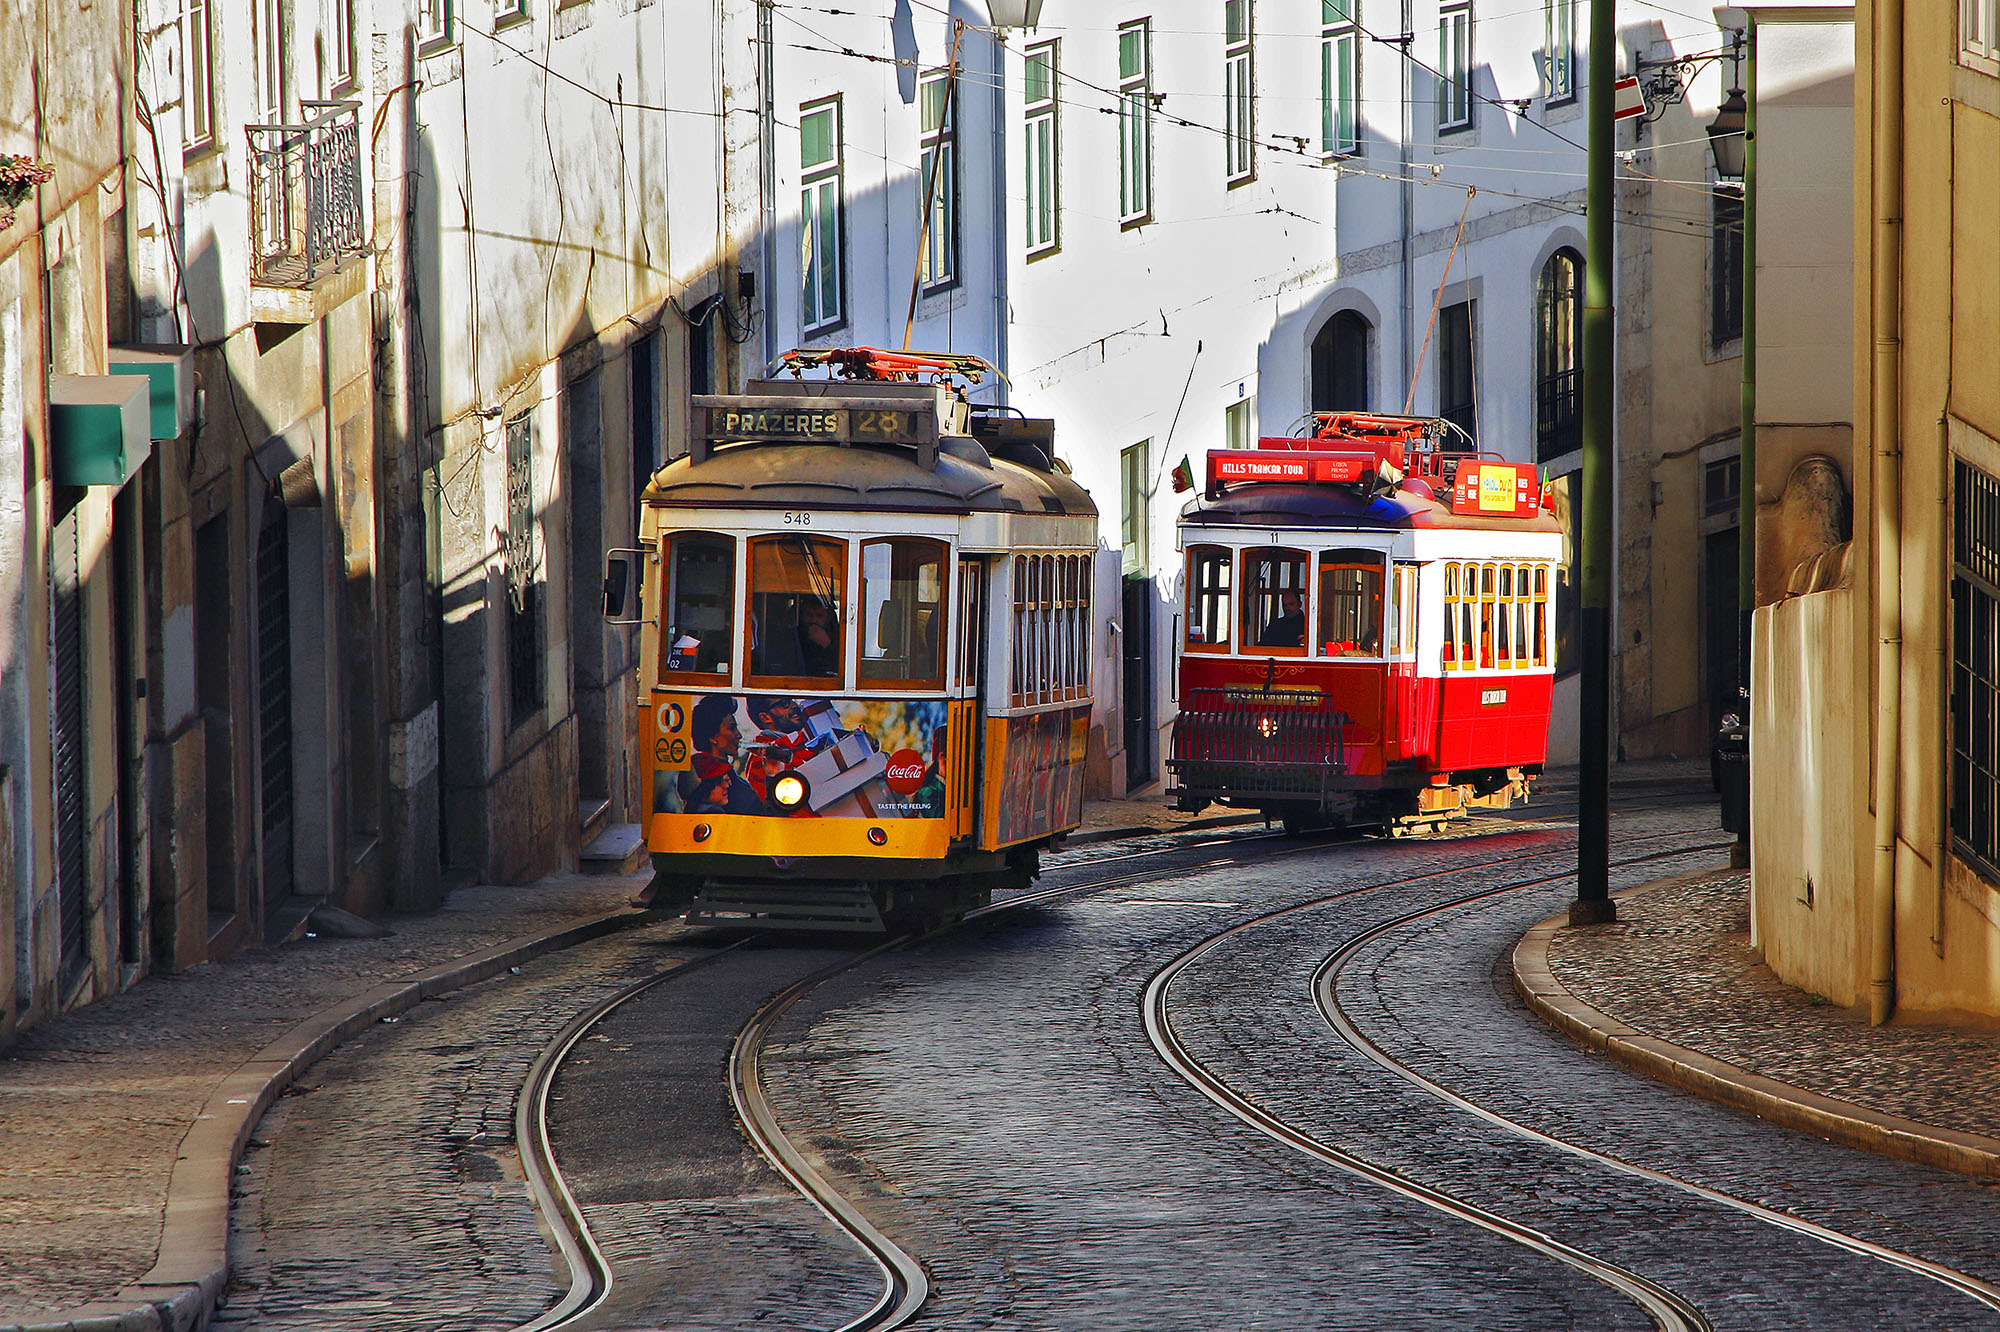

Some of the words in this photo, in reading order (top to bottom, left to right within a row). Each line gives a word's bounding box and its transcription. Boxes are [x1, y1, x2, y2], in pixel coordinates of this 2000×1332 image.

[726, 413, 838, 432] PRAZERES
[858, 410, 899, 432] 28
[1222, 463, 1246, 474] HILLS
[1247, 464, 1282, 474] TRAMCAR
[1283, 465, 1304, 475] TOUR
[783, 512, 811, 526] 548
[1270, 532, 1279, 544] 11
[669, 660, 680, 669] 02
